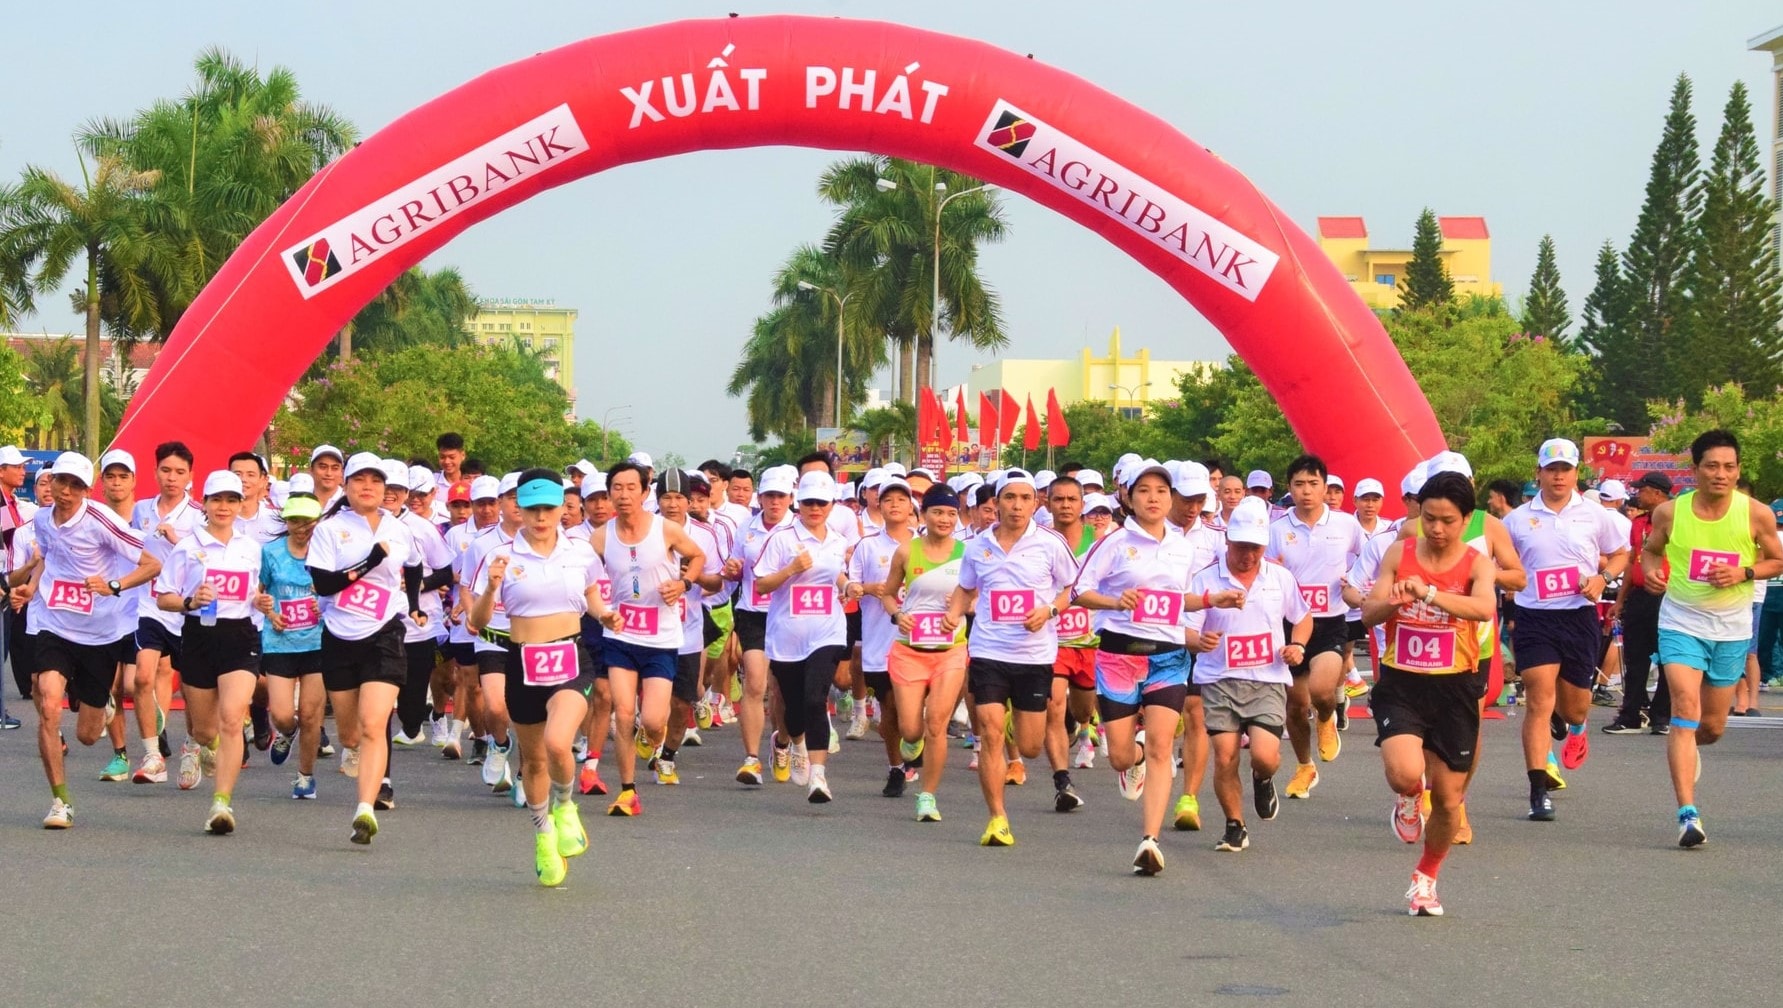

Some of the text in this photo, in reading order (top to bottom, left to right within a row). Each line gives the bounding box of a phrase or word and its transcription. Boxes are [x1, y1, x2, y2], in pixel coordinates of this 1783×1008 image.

[619, 43, 949, 129] XUẤT PHÁT
[350, 125, 576, 265] AGRIBANK
[1027, 147, 1259, 290] AGRIBANK
[215, 574, 240, 593] 20
[1545, 571, 1570, 591] 61
[55, 584, 91, 606] 135
[350, 584, 380, 609] 32
[800, 590, 825, 608] 44
[998, 594, 1025, 614] 02
[1144, 594, 1171, 617] 03
[286, 603, 309, 622] 35
[625, 609, 648, 628] 71
[1056, 612, 1087, 631] 230
[919, 616, 942, 635] 45
[1230, 637, 1270, 660] 211
[1408, 635, 1441, 659] 04
[534, 650, 564, 673] 27
[1405, 659, 1443, 667] AGRIBANK
